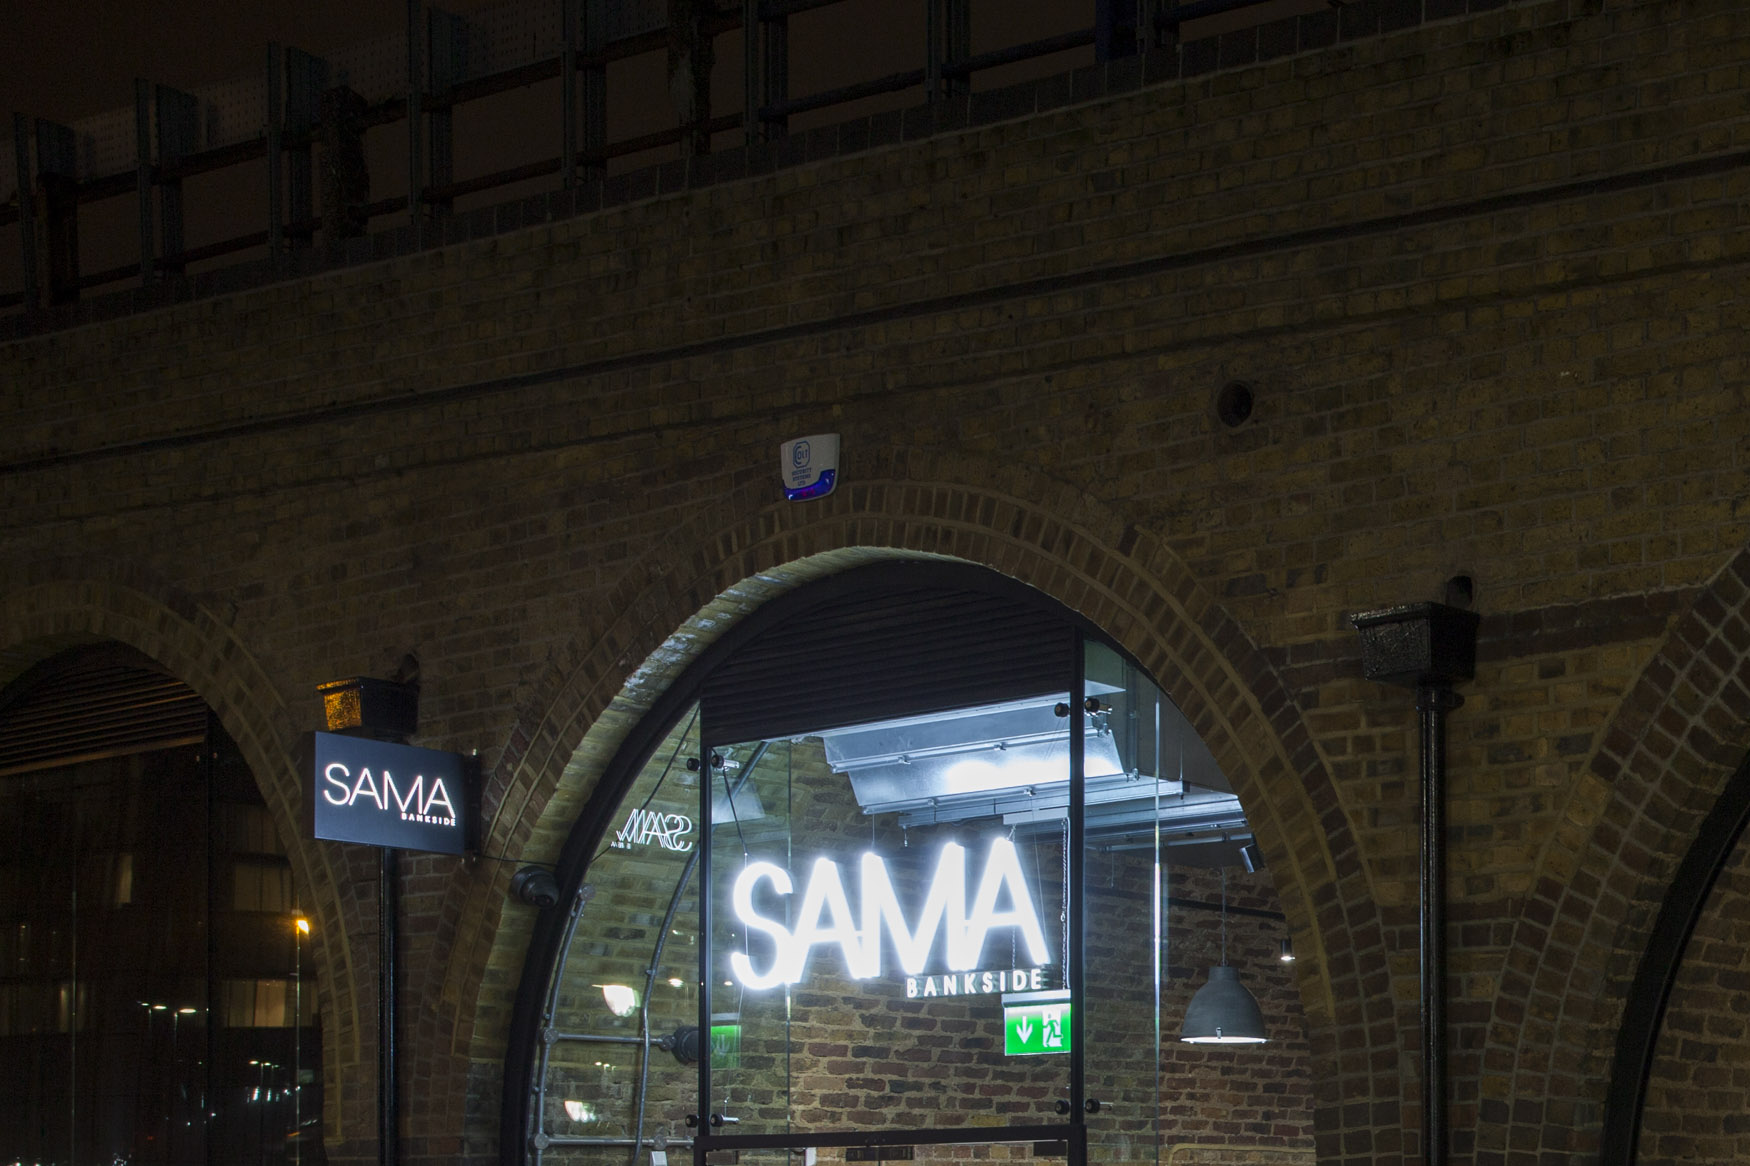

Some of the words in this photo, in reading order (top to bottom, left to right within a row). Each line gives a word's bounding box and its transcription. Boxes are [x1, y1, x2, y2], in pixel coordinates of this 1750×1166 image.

[323, 763, 456, 818] SAMA
[401, 812, 457, 827] BANKSIDE
[730, 836, 1051, 990] SAMA
[906, 970, 1043, 999] BANKSIDE
